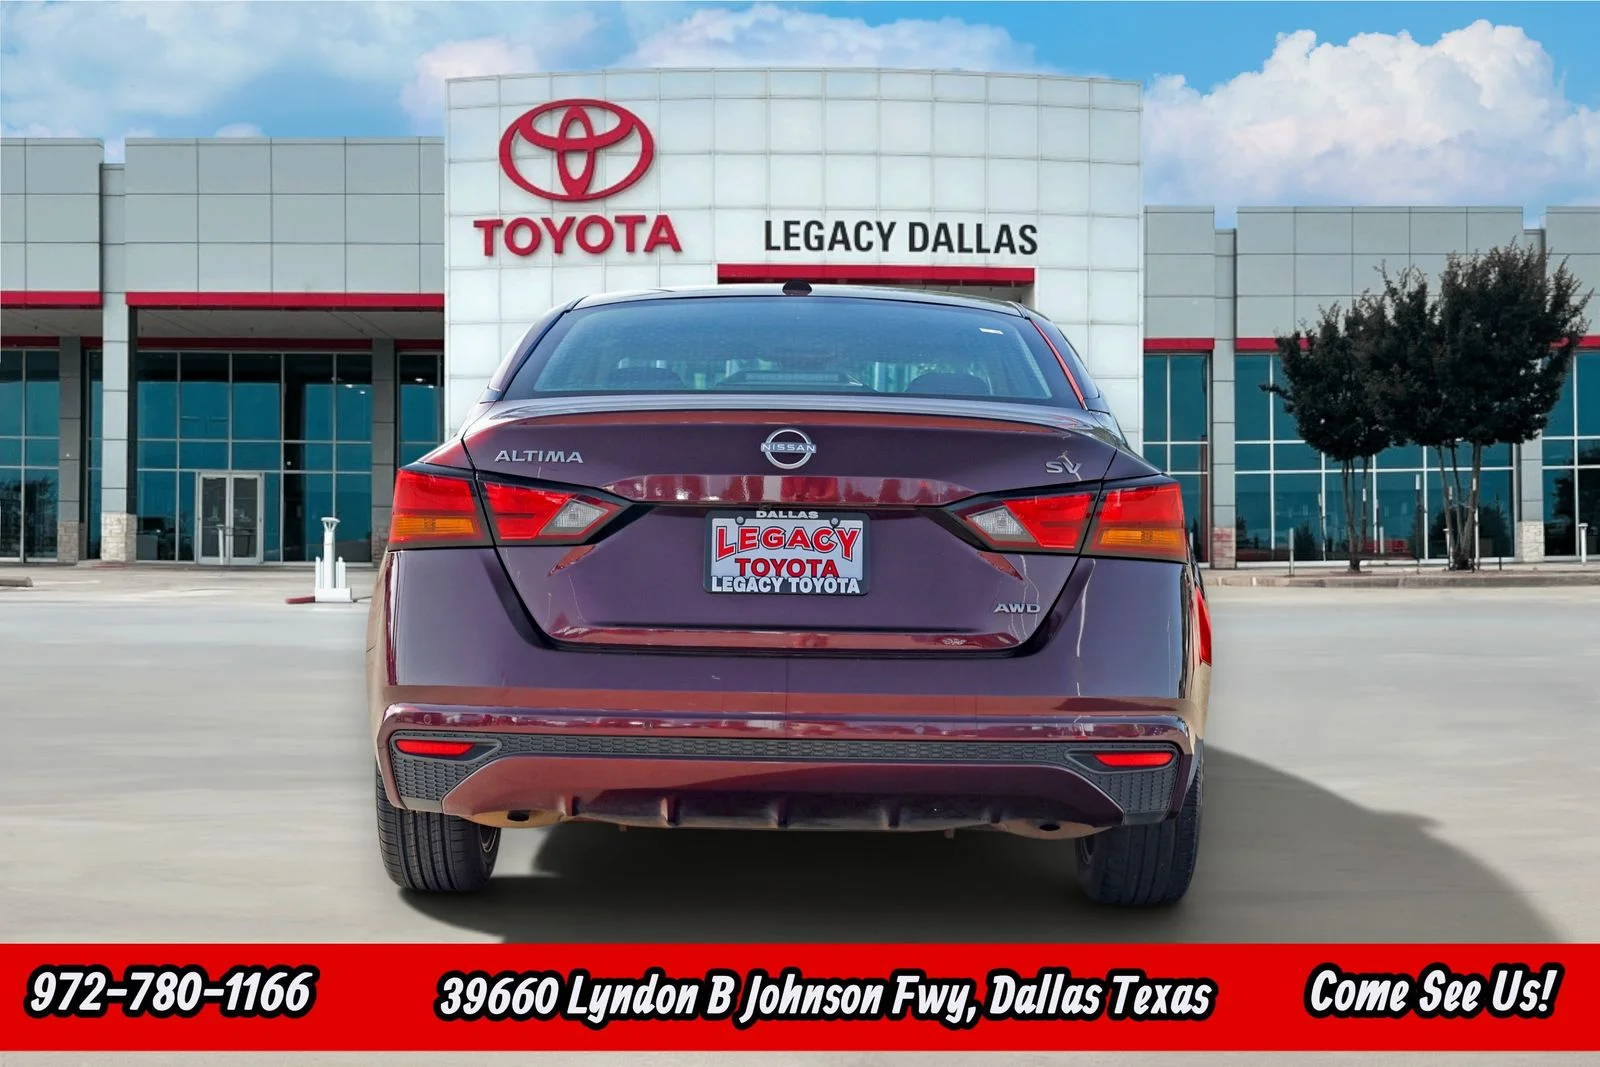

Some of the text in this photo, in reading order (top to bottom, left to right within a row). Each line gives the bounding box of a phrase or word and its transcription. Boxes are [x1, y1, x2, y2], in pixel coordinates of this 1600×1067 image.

[473, 214, 682, 256] TOYOTA
[764, 220, 1038, 255] LEGACY DALLAS
[762, 444, 815, 452] NISSAN
[494, 450, 584, 463] ALTIMA
[1045, 461, 1082, 474] SV
[756, 511, 819, 519] DALLAS
[715, 525, 862, 562] LEGACY
[735, 558, 840, 578] TOYOTA
[711, 576, 860, 594] LEGACY TOYOTA
[993, 603, 1040, 613] AWD
